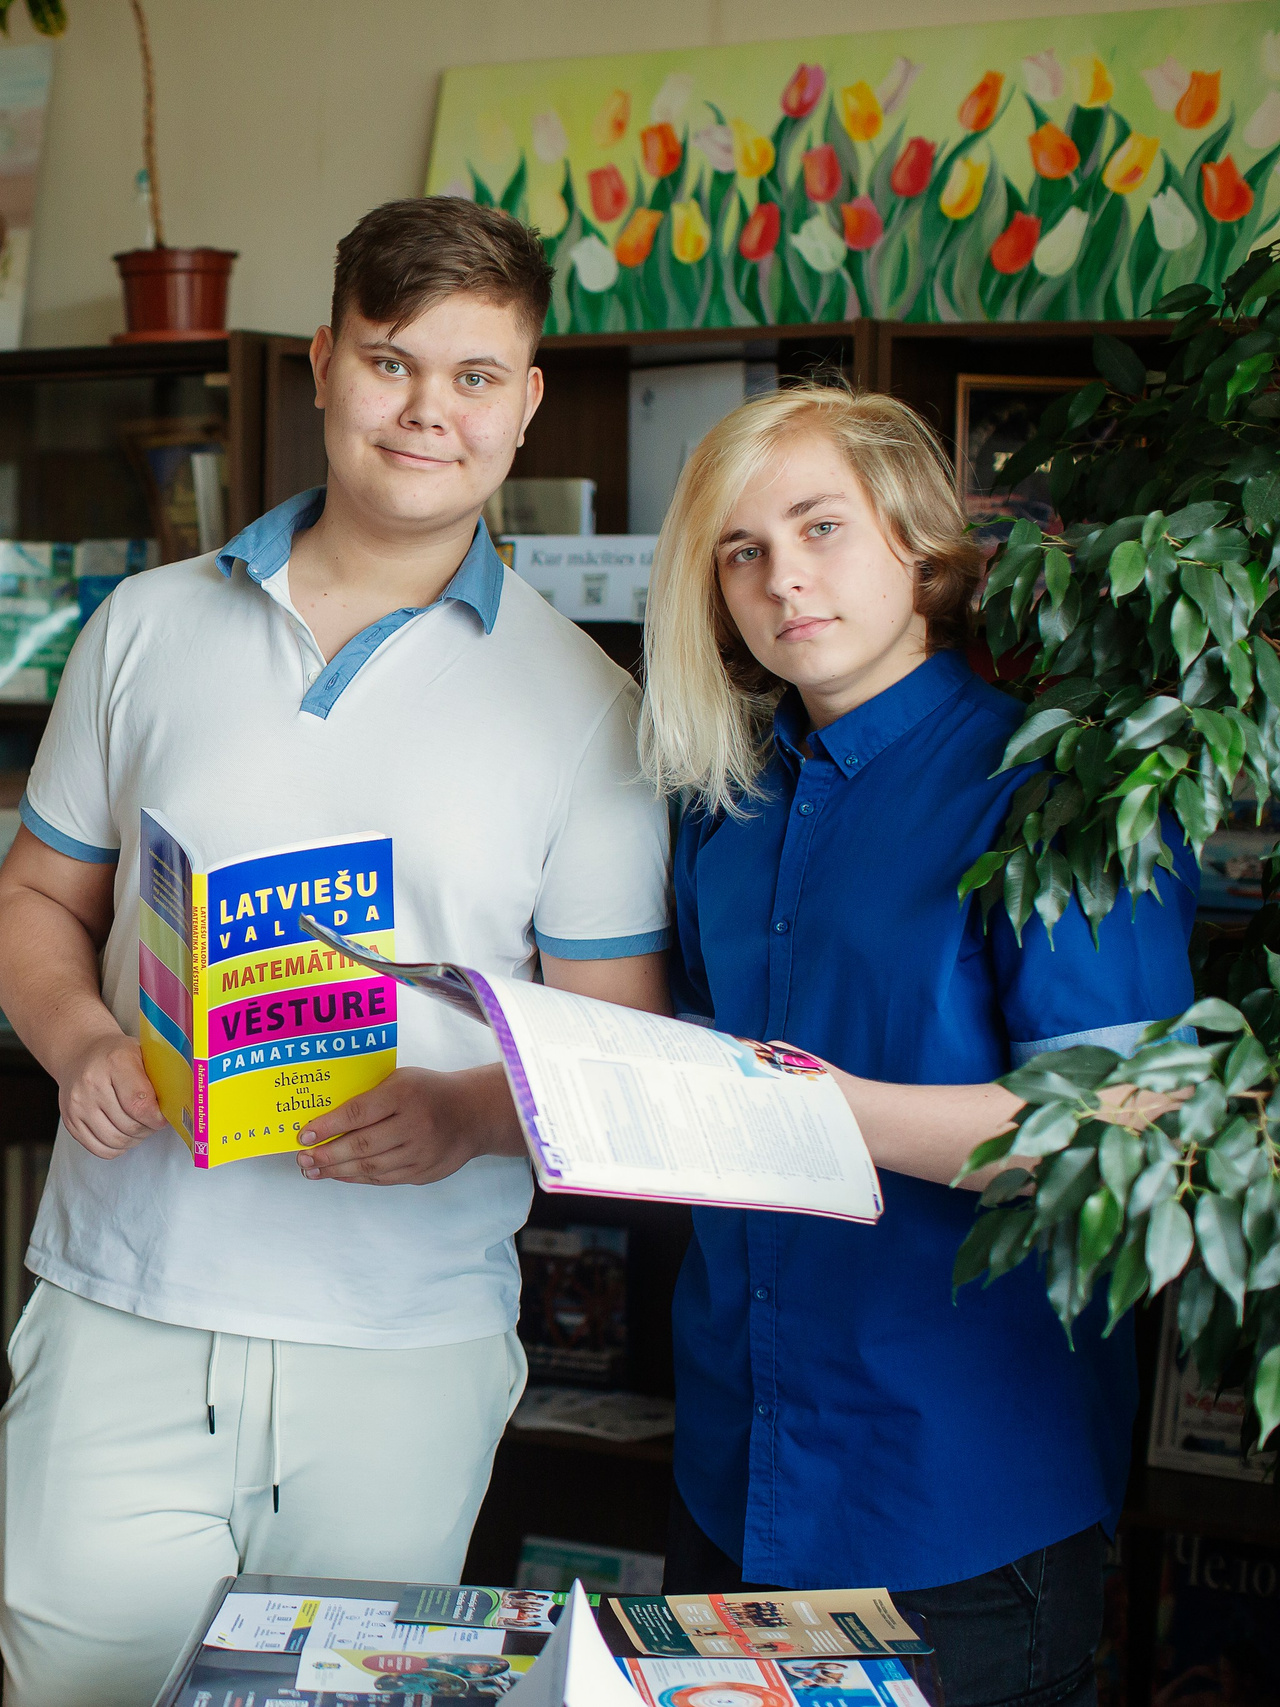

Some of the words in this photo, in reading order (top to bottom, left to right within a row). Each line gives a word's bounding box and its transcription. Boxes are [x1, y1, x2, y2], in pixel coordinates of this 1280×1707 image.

[219, 870, 379, 926] LATVIEŠU
[192, 953, 198, 964] UN
[221, 987, 387, 1041] VĒSTURE
[222, 1030, 387, 1073] PAMATSKOLAI
[274, 1069, 331, 1088] shēmās
[198, 1093, 203, 1104] un
[296, 1085, 310, 1095] un
[275, 1093, 332, 1113] tabulās
[198, 1105, 206, 1133] tabulās
[222, 1120, 303, 1145] ROKASG
